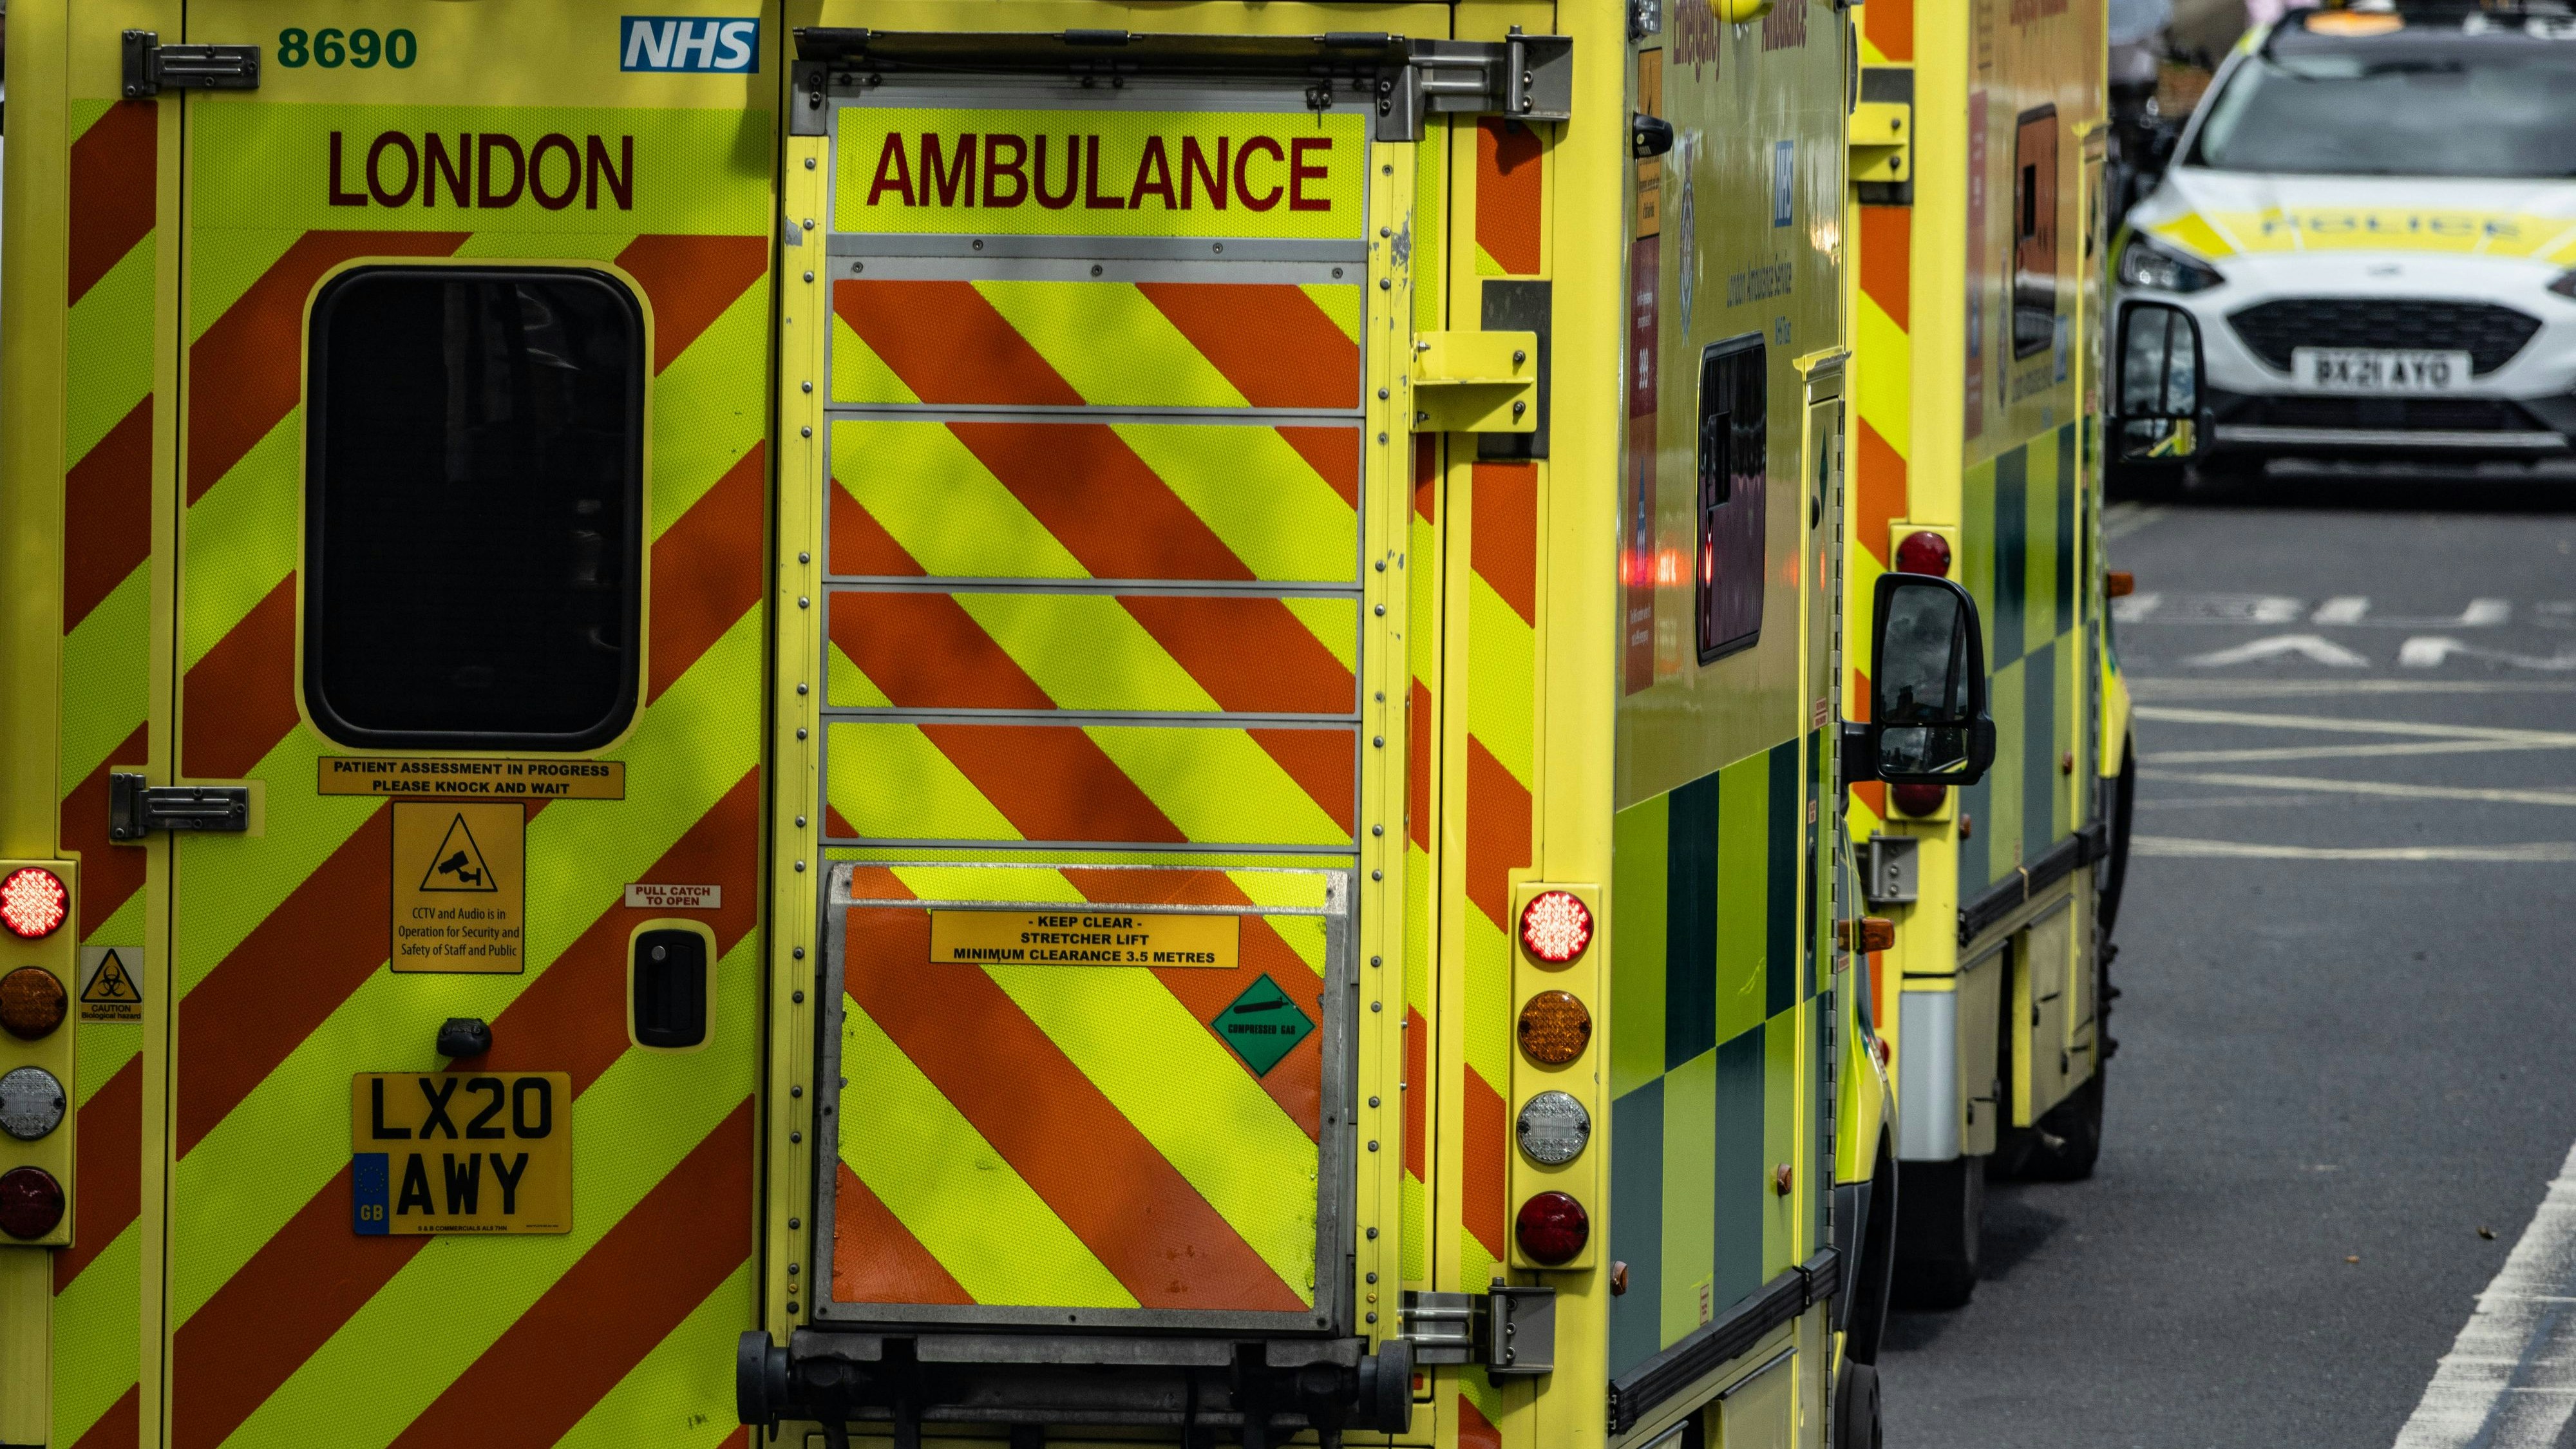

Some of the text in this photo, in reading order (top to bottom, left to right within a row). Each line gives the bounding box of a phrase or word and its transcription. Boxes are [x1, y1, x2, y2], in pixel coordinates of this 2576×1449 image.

[277, 28, 417, 69] 8690
[623, 20, 755, 70] NHS
[328, 131, 633, 211] LONDON
[866, 131, 1332, 212] AMBULANCE
[1775, 147, 1793, 220] NHS
[2262, 212, 2521, 239] POLICE
[1639, 348, 1649, 390] 999
[334, 761, 610, 777] PATIENT ASSESSMENT IN PROGRESS
[373, 780, 570, 794] PLEASE KNOCK AND WAIT
[636, 887, 711, 896] PULL CATCH
[647, 896, 700, 905] TO OPEN
[412, 907, 506, 920] CCTV and Audio is in
[1037, 916, 1078, 928] KEEP
[1083, 916, 1133, 929] CLEAR
[398, 925, 520, 941] Operation for Security and
[1020, 933, 1150, 945] STRETCHER LIFT
[401, 943, 517, 958] Safety of Staff and Public
[953, 948, 1215, 963] MINIMUM CLEARANCE 3.5 METRES
[1228, 1024, 1296, 1035] COMPRESSED GAS
[372, 1077, 552, 1140] LX20
[396, 1153, 529, 1215] AWY
[360, 1204, 383, 1221] GB
